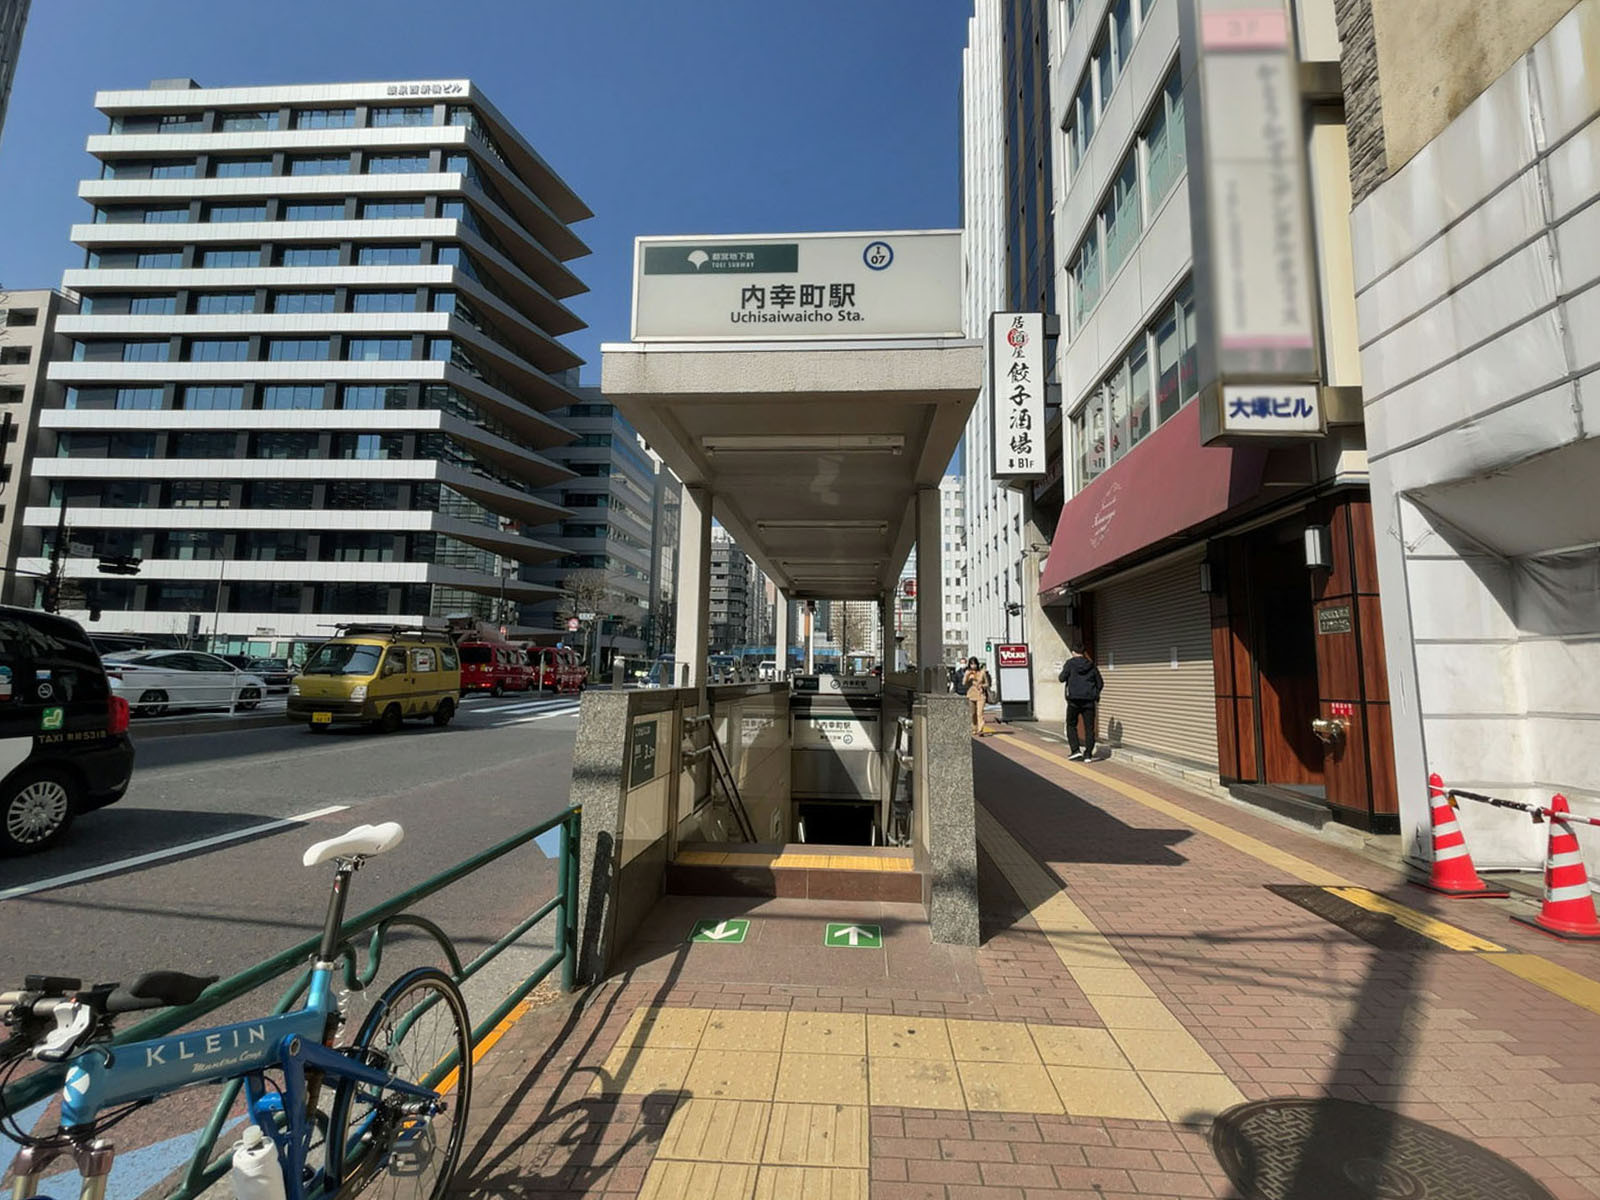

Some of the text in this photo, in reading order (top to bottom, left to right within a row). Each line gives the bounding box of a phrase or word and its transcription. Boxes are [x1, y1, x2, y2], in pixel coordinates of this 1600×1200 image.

[871, 255, 886, 265] 07
[741, 283, 856, 310] 内幸町駅
[730, 310, 865, 324] Uchisaiwaicho Sta.
[1007, 361, 1033, 455] 餃子酒場
[1229, 396, 1313, 419] 大塚ビル
[1018, 458, 1035, 469] B1F
[39, 734, 64, 744] TAXI
[146, 1024, 265, 1068] KLEIN
